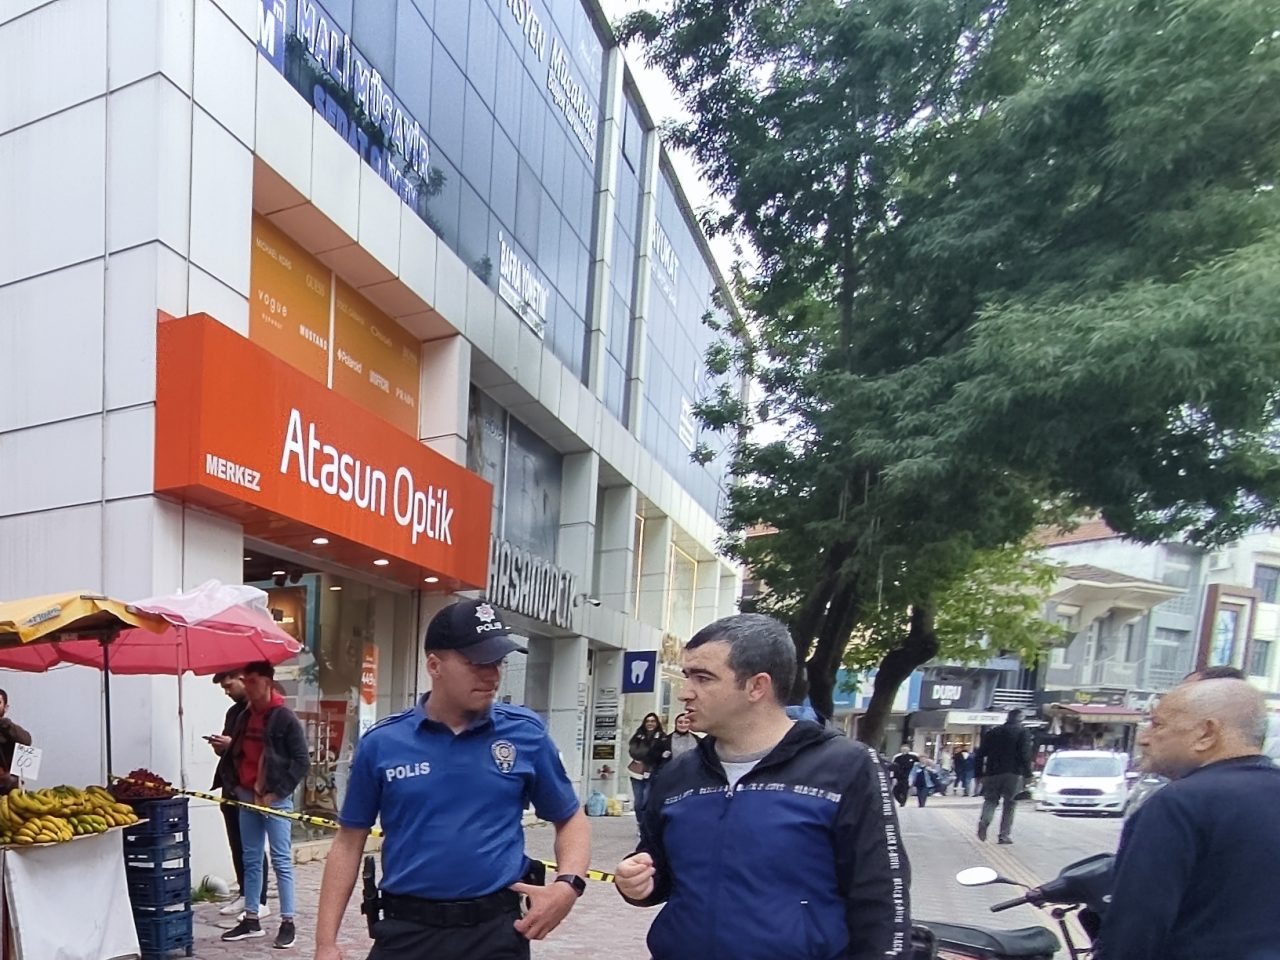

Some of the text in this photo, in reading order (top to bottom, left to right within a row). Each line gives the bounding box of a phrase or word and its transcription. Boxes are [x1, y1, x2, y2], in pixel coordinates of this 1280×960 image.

[258, 290, 287, 316] vogue
[299, 324, 327, 350] MUSTANG
[206, 453, 261, 492] MERKEZ
[280, 408, 454, 544] Atasun Optik
[932, 685, 962, 699] DURU
